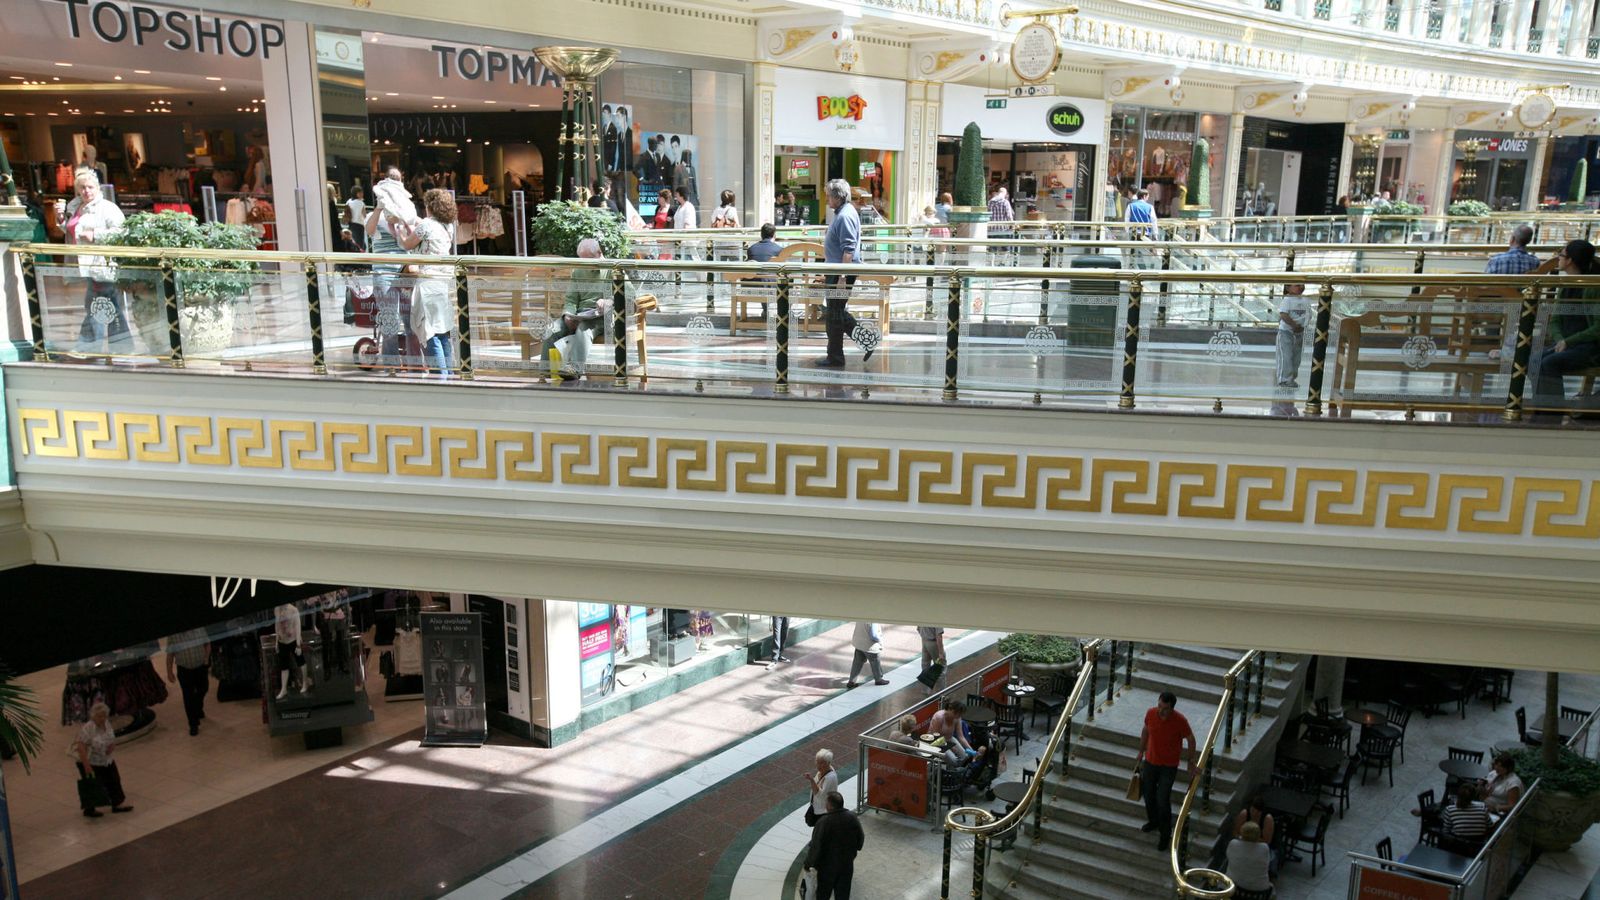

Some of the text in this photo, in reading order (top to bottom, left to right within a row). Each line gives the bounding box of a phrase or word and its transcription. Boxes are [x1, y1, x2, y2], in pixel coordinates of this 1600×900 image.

[55, 0, 284, 59] TOPSHOP
[817, 94, 867, 120] BOOST
[373, 116, 467, 137] TOPMAN
[1053, 111, 1080, 126] schuh
[1498, 139, 1528, 152] JONES
[1328, 157, 1337, 193] KAREN
[429, 617, 472, 625] Also available
[871, 762, 923, 779] COFFEE LOUNGE
[1363, 886, 1400, 900] COFFEE
